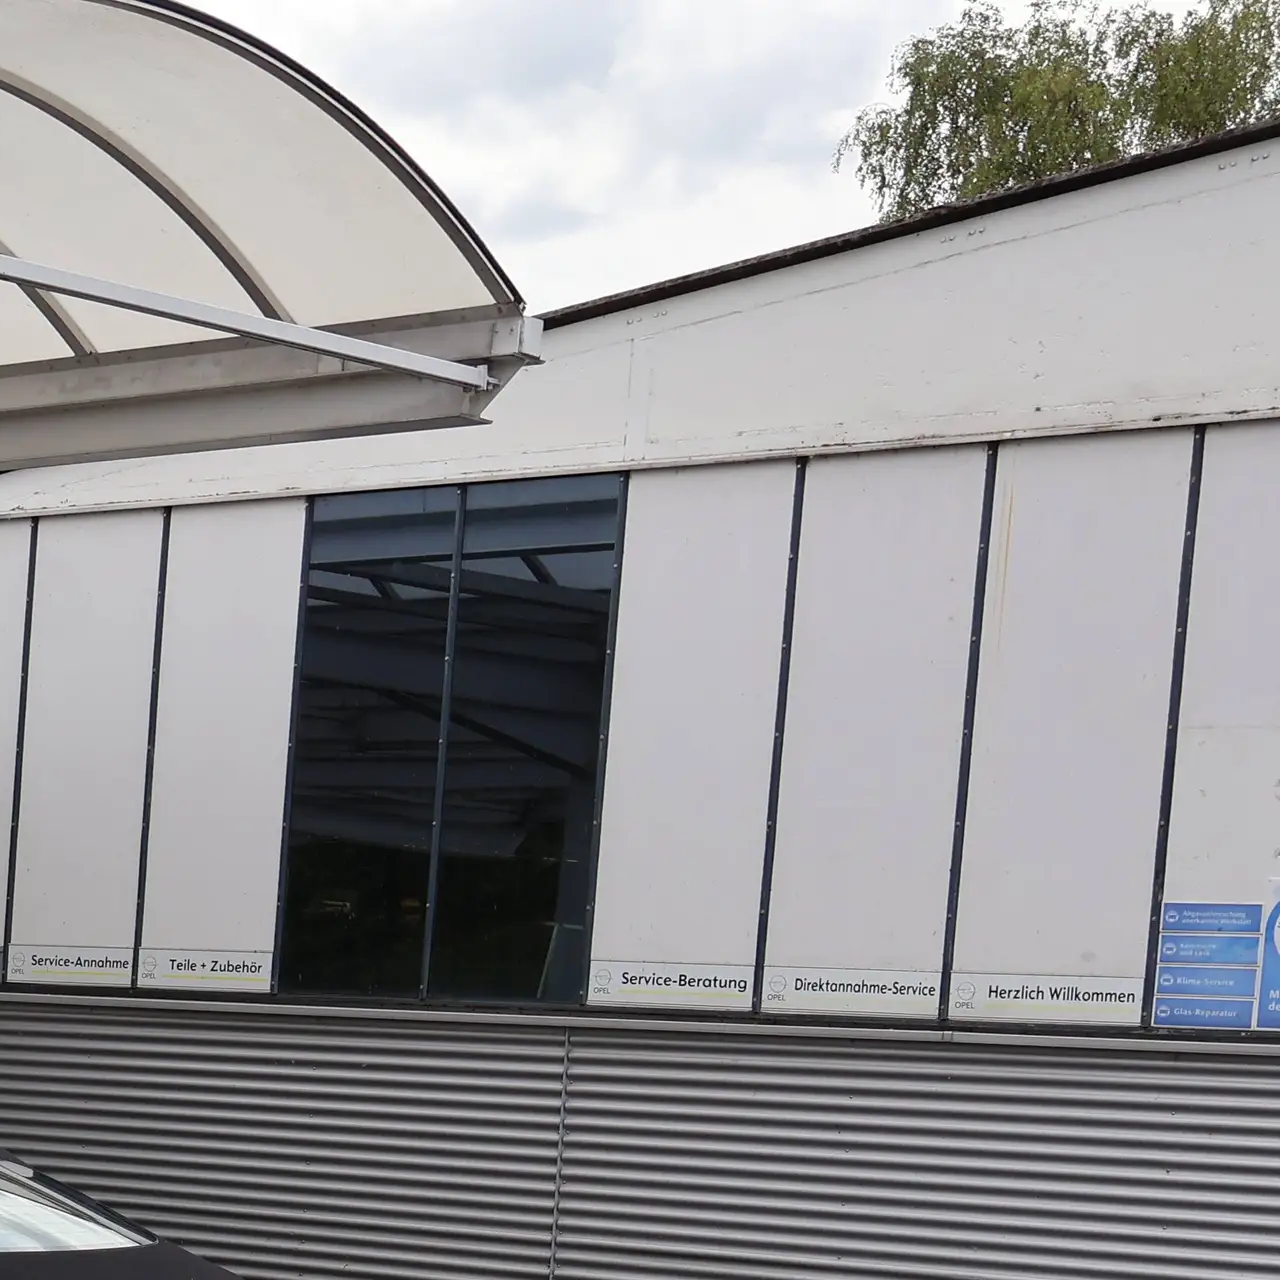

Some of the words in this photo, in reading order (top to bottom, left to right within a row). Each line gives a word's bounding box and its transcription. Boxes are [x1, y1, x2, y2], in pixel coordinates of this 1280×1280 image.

[31, 955, 129, 969] Service-Annahme
[169, 959, 197, 971] Teile
[210, 960, 262, 973] Zubehör
[621, 972, 748, 992] Service-Beratung
[794, 978, 936, 996] Direktannahme-Service
[1176, 976, 1235, 986] Klima-Service
[988, 985, 1045, 1001] Herzlich
[1049, 987, 1136, 1004] Willkommen
[1173, 1007, 1237, 1019] Glas-Reparatur
